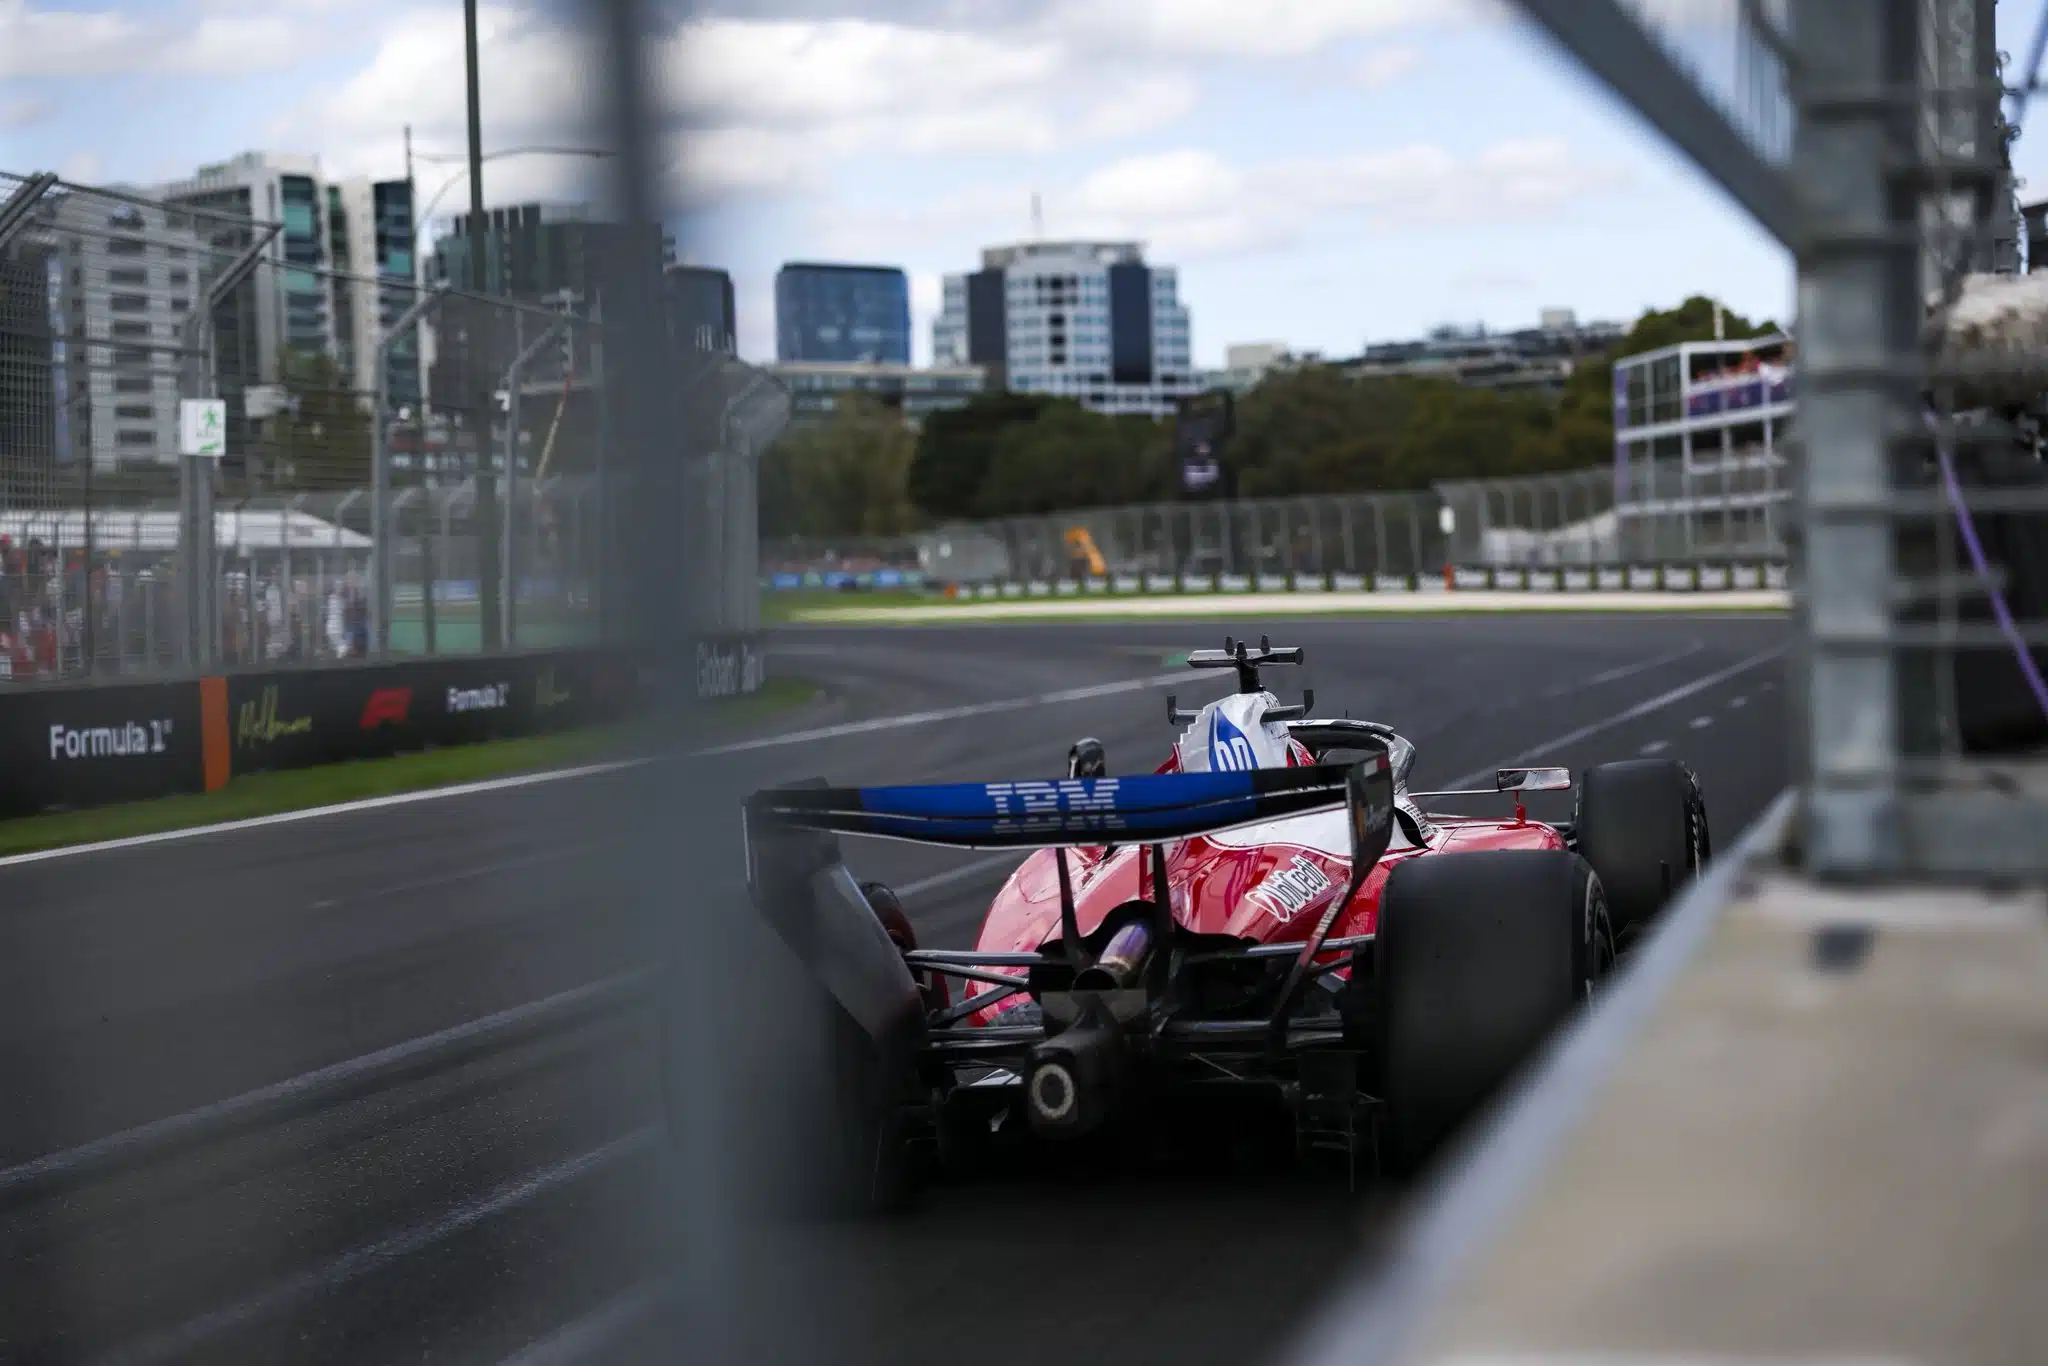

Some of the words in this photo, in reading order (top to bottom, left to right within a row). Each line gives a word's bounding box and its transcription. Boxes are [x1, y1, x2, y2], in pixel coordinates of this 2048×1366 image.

[49, 720, 148, 760] Formula
[985, 778, 1127, 834] IBM
[1256, 855, 1331, 913] UniCredit
